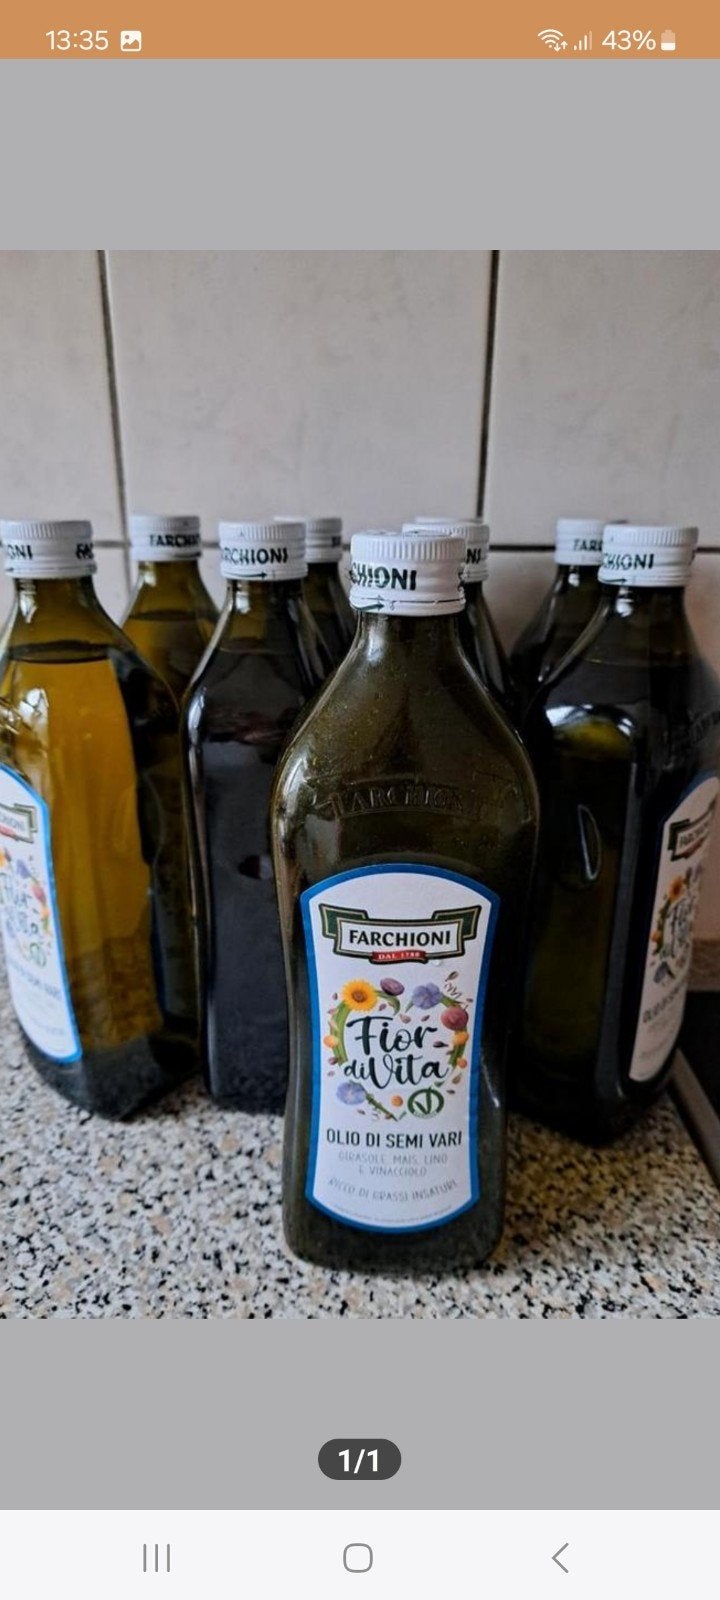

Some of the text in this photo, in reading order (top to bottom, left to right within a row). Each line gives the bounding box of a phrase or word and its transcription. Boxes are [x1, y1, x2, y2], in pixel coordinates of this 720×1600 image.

[349, 929, 450, 947] FARCHIONI
[346, 1015, 437, 1055] Fior
[367, 1053, 450, 1090] Vita
[326, 1128, 462, 1149] OLIO DI SEMI VARI
